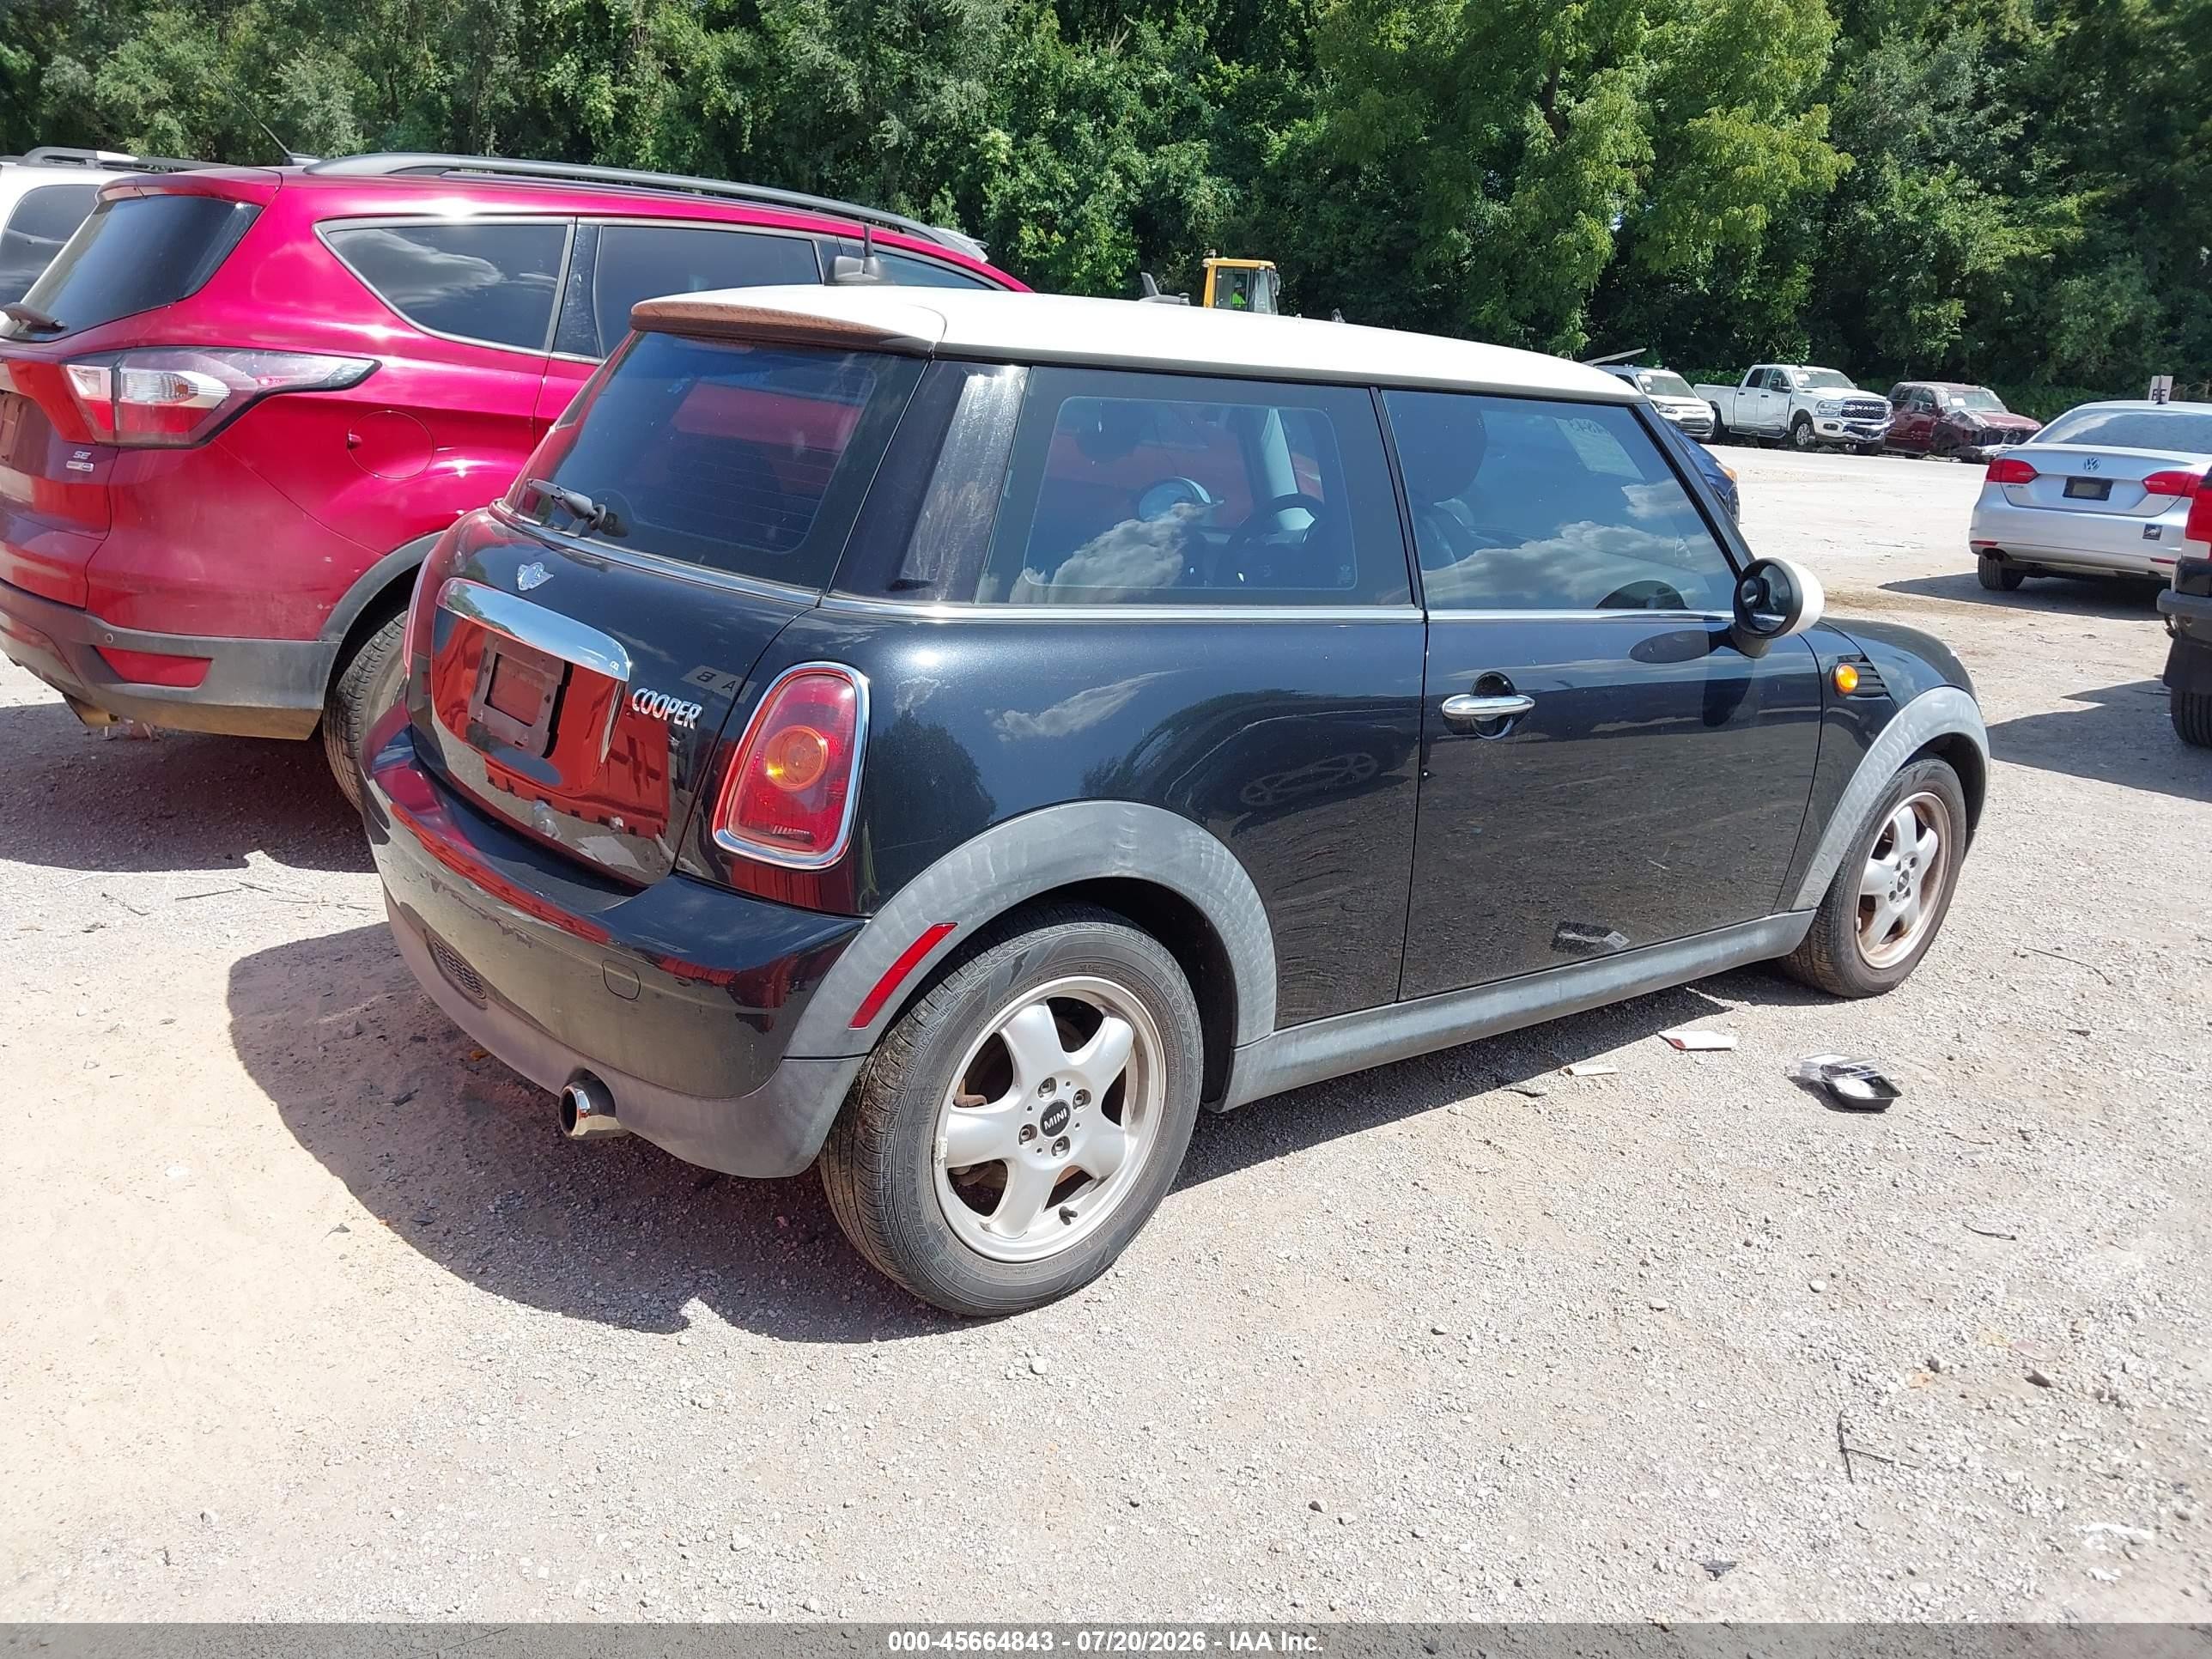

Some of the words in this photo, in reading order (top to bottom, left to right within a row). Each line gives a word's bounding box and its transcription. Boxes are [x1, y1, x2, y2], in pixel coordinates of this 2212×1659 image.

[73, 451, 92, 459] SE
[632, 688, 702, 730] COOPER
[1043, 1108, 1066, 1130] MINI
